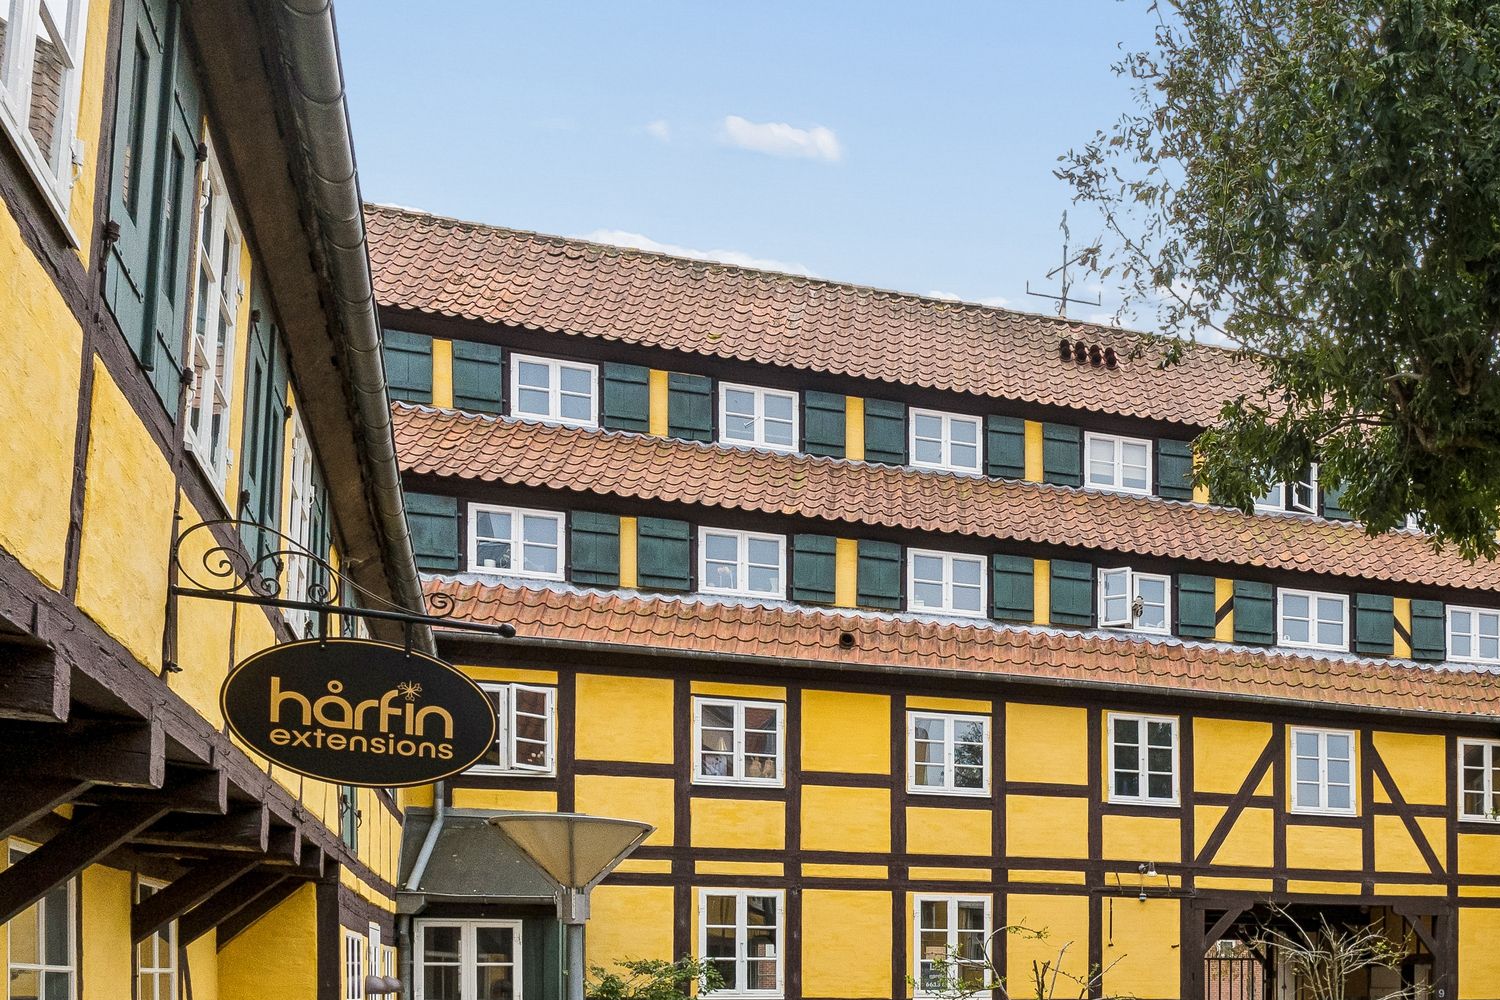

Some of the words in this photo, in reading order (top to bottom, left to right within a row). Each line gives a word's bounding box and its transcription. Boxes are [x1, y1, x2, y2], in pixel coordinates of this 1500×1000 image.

[270, 676, 454, 739] hårfin
[269, 727, 454, 760] extensions
[1438, 988, 1445, 998] 9
